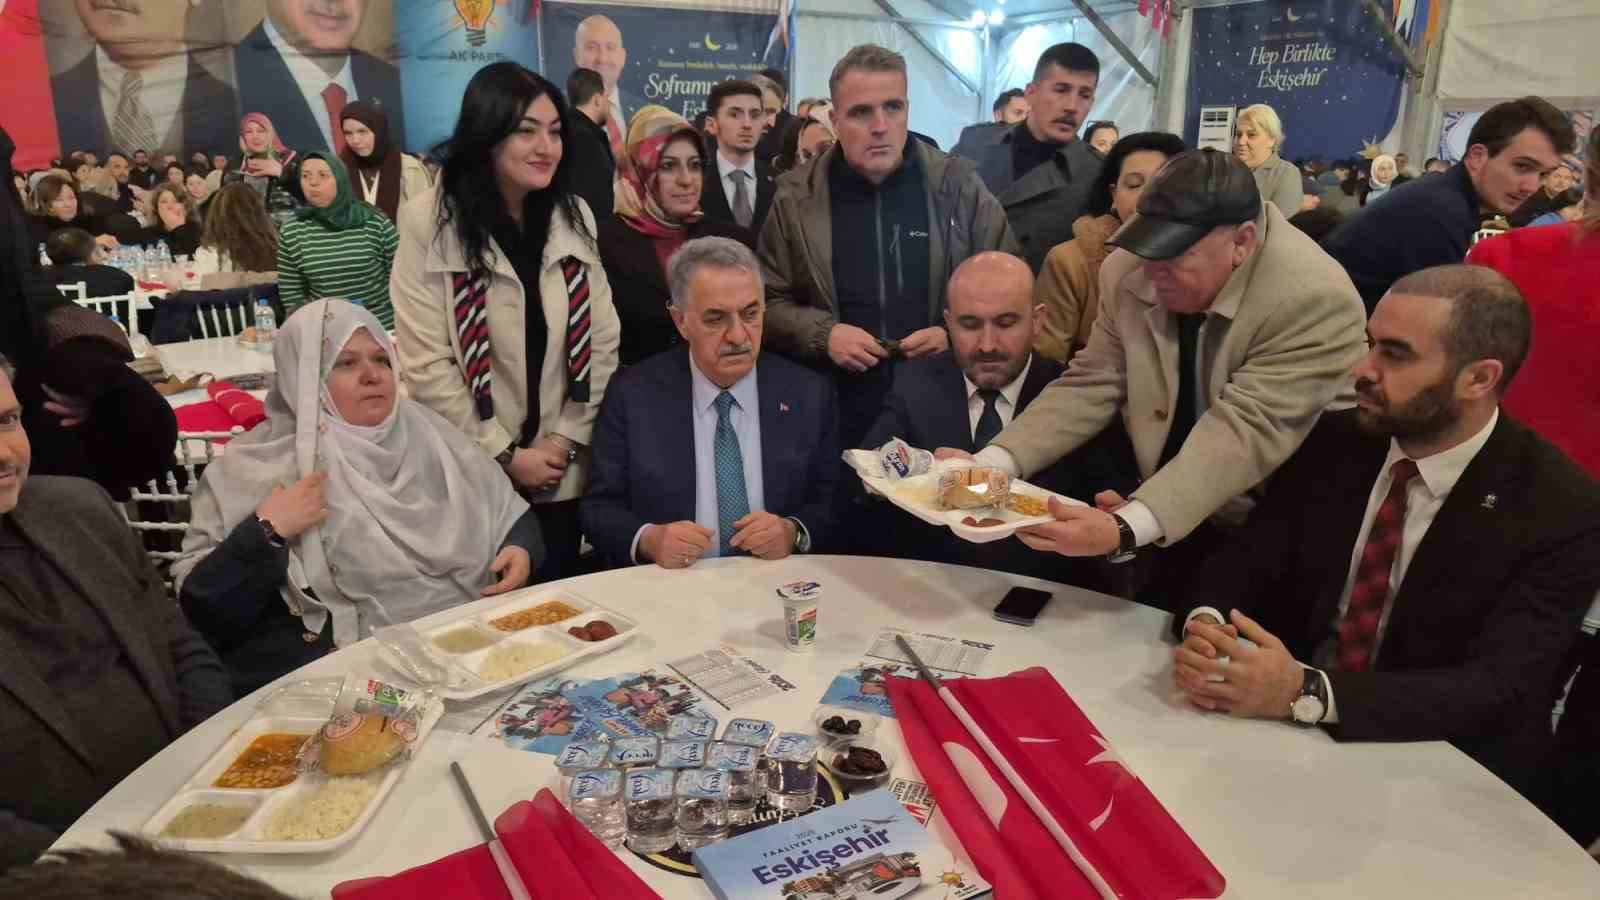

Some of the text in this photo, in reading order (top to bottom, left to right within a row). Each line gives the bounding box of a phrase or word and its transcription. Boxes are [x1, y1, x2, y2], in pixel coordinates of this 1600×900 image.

[1249, 42, 1336, 74] Hep Birlikte
[1257, 66, 1328, 91] Eskişehir
[751, 828, 891, 885] Eskişehir
